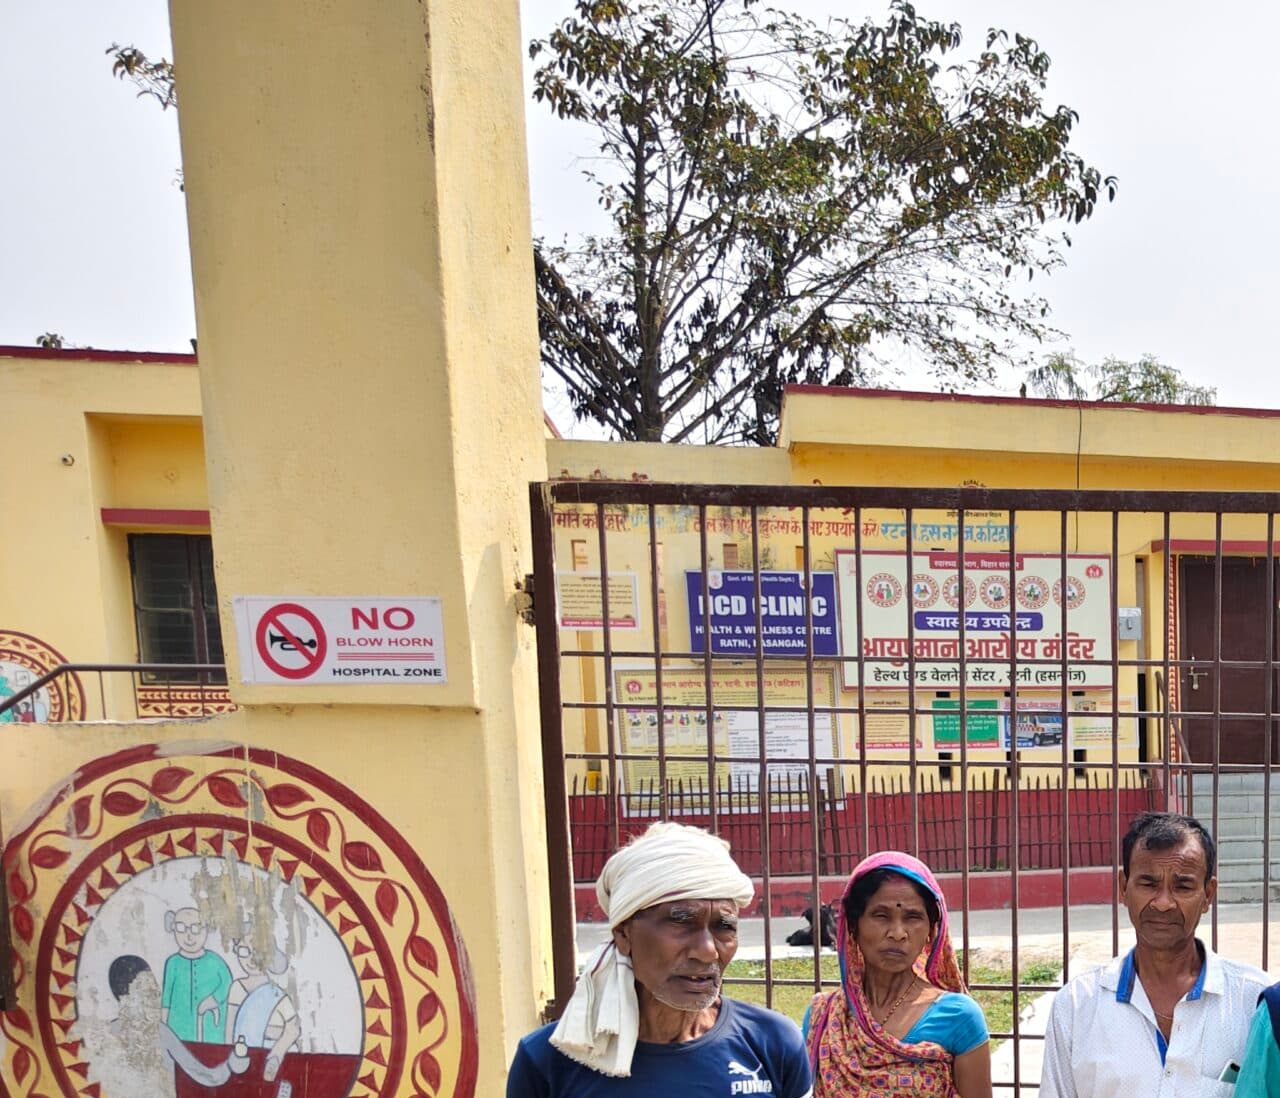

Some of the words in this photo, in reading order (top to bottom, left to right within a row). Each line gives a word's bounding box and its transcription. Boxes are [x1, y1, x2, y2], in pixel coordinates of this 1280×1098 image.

[698, 595, 748, 616] NCD
[752, 596, 828, 617] CLINC
[351, 607, 415, 630] NO
[695, 625, 733, 635] HALTH
[735, 625, 742, 634] &
[744, 625, 794, 635] WELNESS
[795, 626, 832, 636] CETRE
[336, 637, 383, 647] BLOW
[388, 637, 433, 647] HORN
[720, 638, 751, 649] RATNI,
[332, 668, 401, 677] HOSPITAL
[404, 668, 442, 677] ZONE
[873, 667, 900, 682] हेल्थ
[931, 667, 968, 682] वेलने
[972, 667, 996, 682] सेंटर
